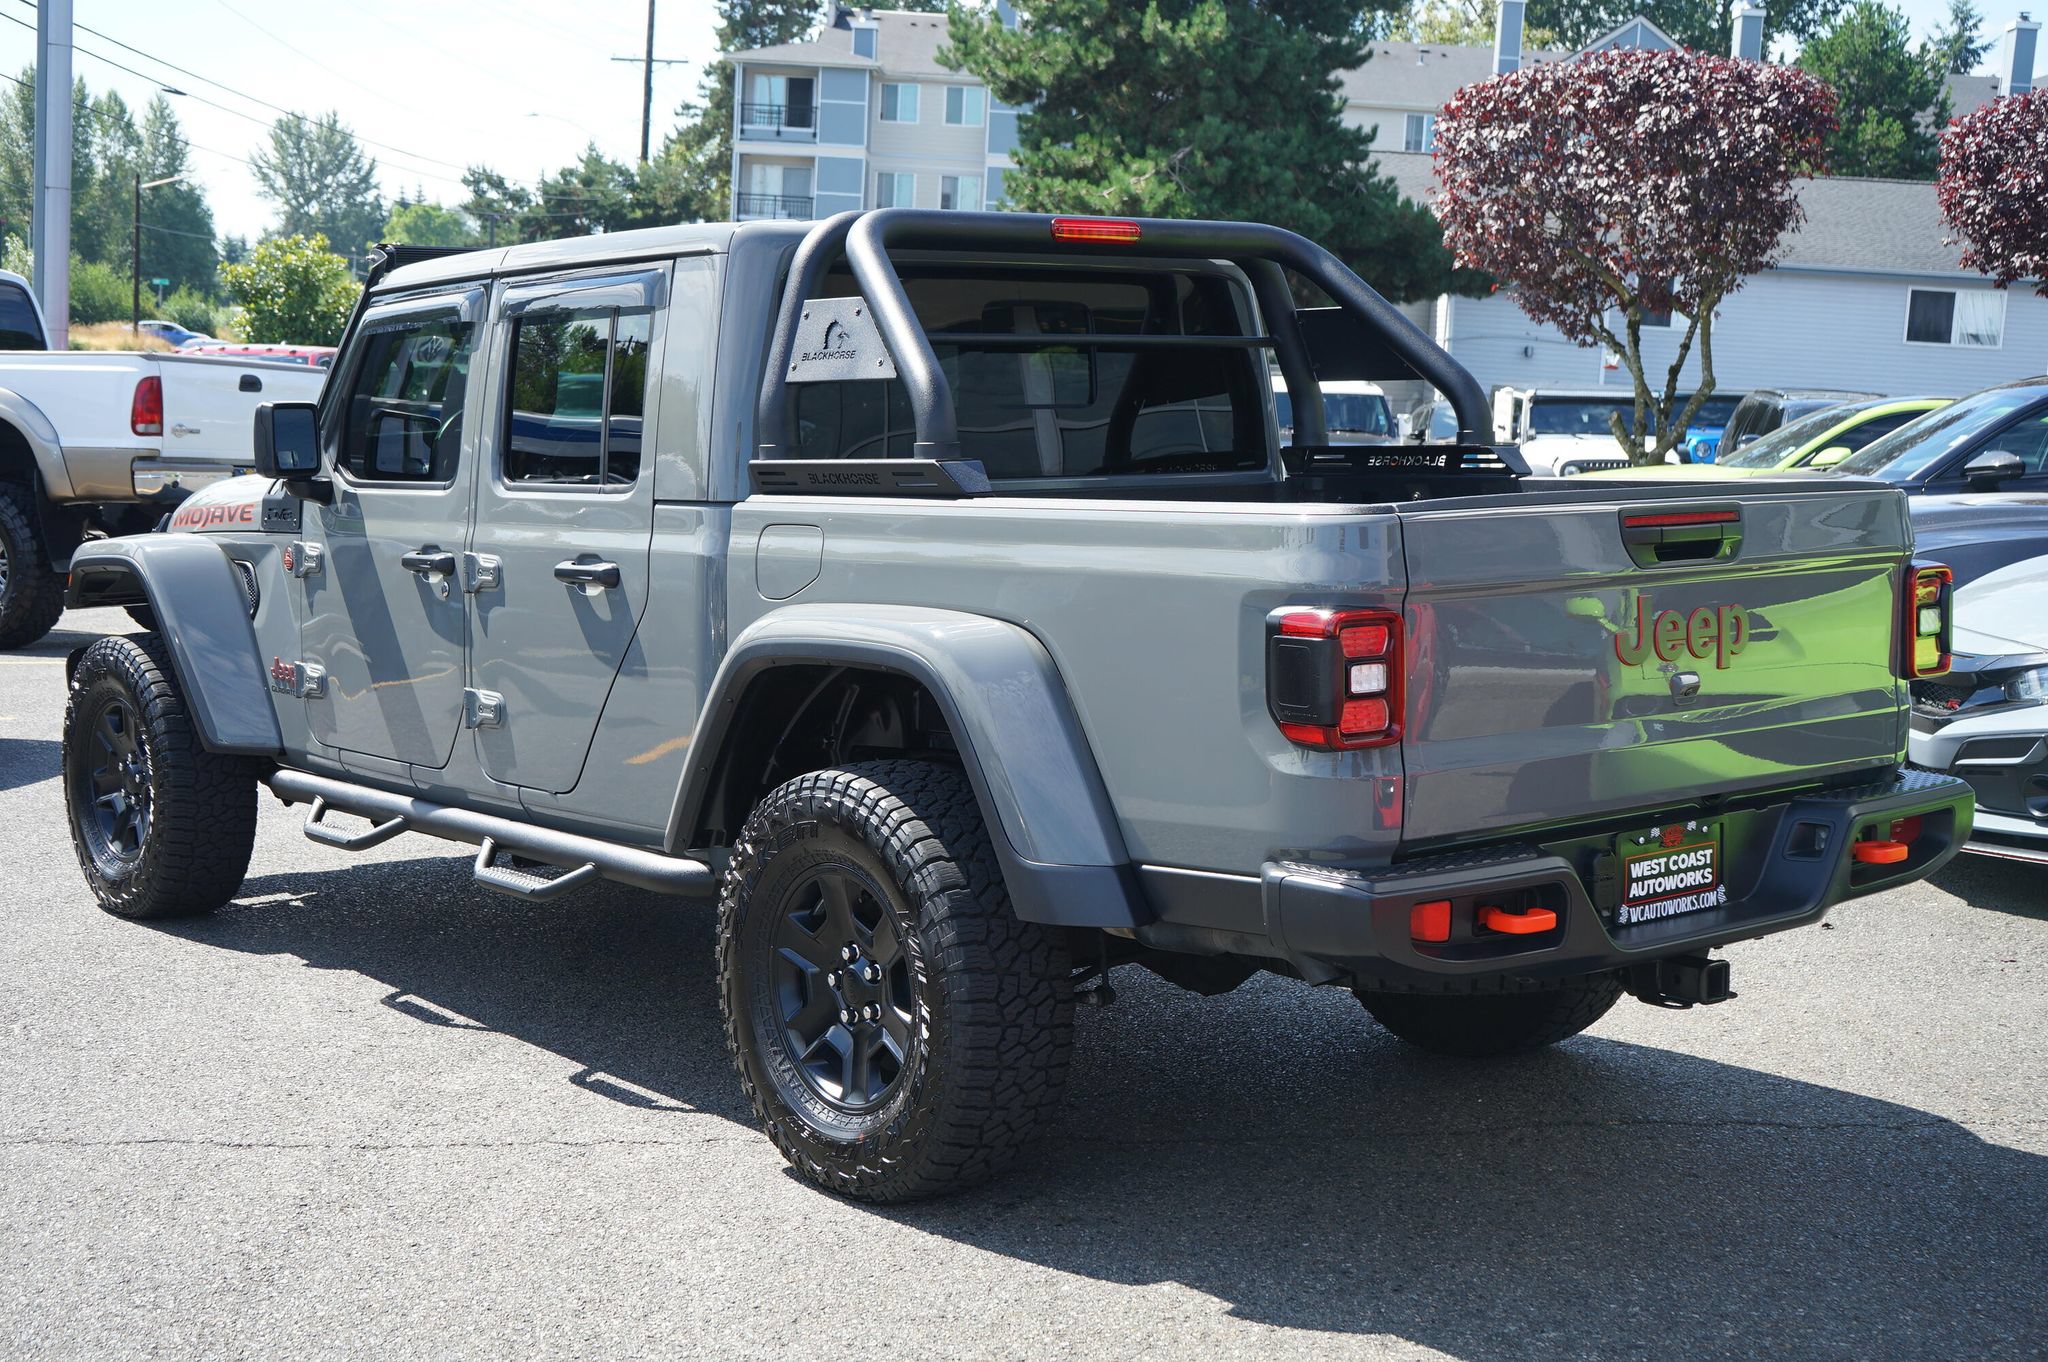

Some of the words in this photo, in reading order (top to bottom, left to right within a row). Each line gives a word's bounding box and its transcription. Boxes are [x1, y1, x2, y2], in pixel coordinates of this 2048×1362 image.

[801, 350, 856, 362] BLACKHORSE
[807, 472, 880, 485] BLACKHORSE
[173, 503, 256, 528] MOJAVE
[1615, 594, 1749, 670] Jeep
[1630, 857, 1668, 879] WEST
[1668, 848, 1713, 871] COAST
[1628, 867, 1713, 899] AUTOWORKS
[1629, 890, 1717, 923] WCAUTOWORKS.COM
